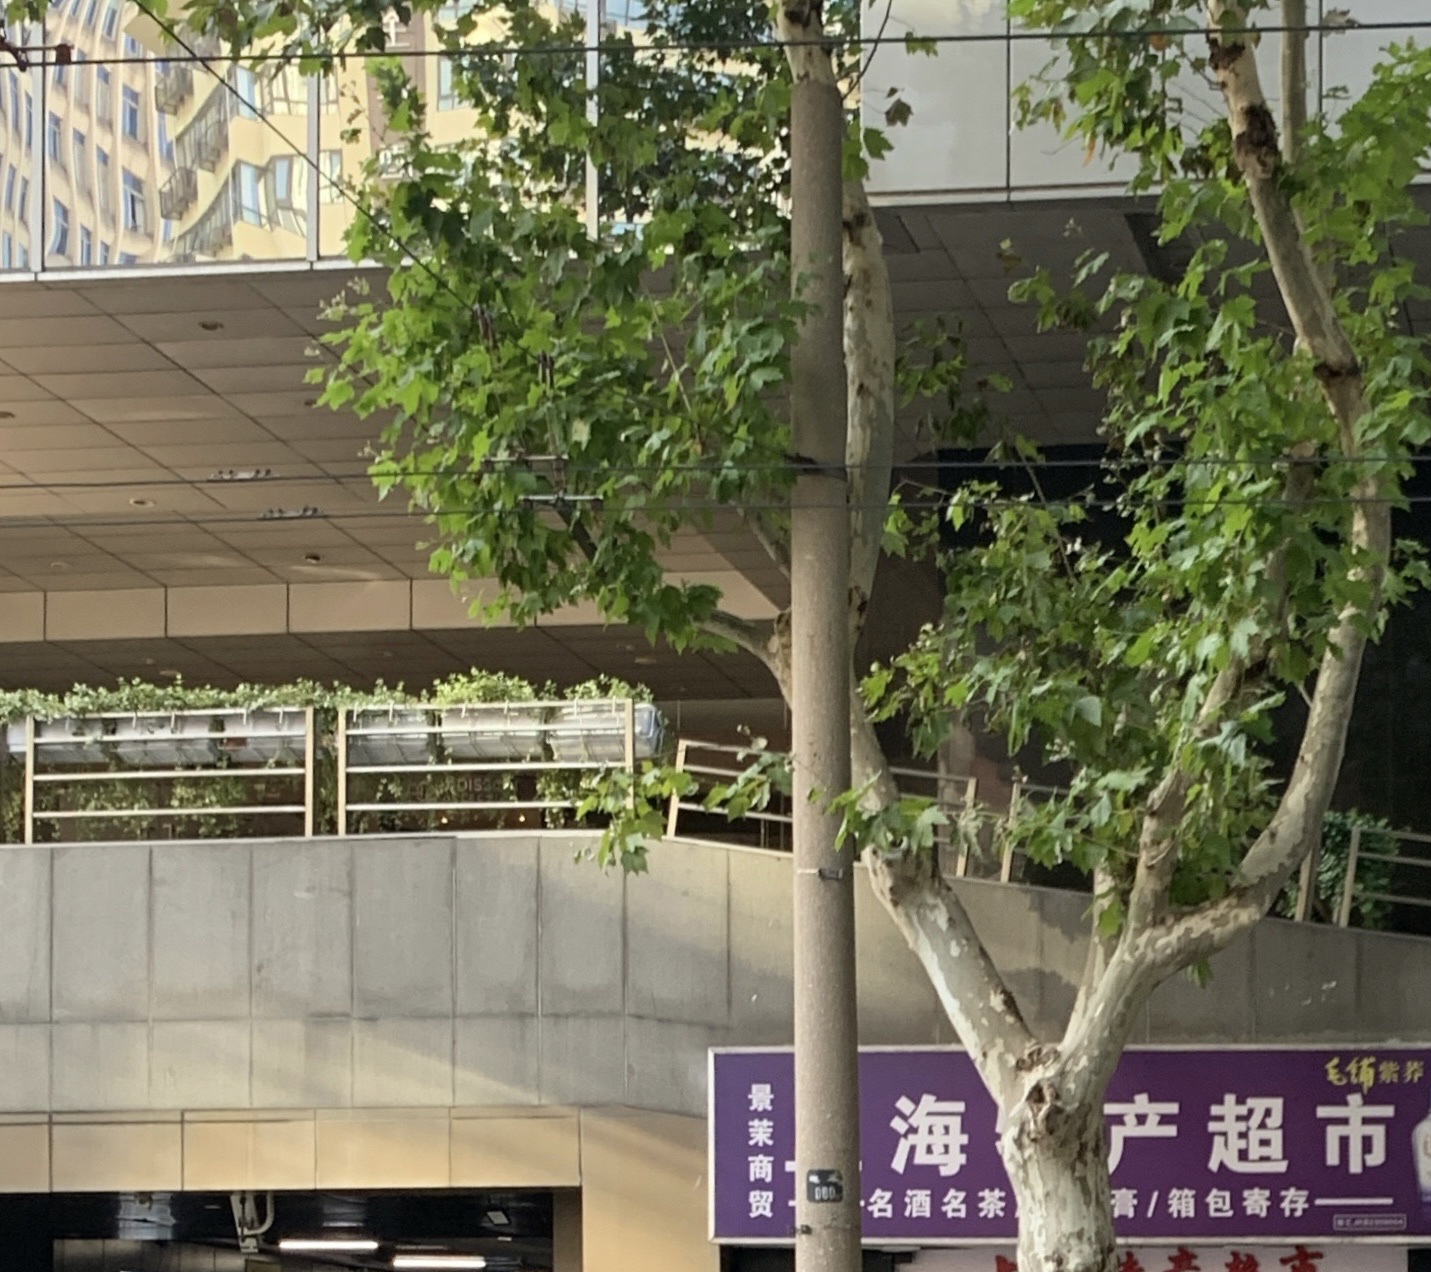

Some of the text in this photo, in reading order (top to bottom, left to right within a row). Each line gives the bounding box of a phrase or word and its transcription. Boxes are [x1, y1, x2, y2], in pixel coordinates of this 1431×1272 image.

[748, 1084, 774, 1218] 景茉商贸
[785, 1091, 1395, 1178] 海产超市
[867, 1187, 1310, 1219] 名酒名茶膏/箱包寄存
